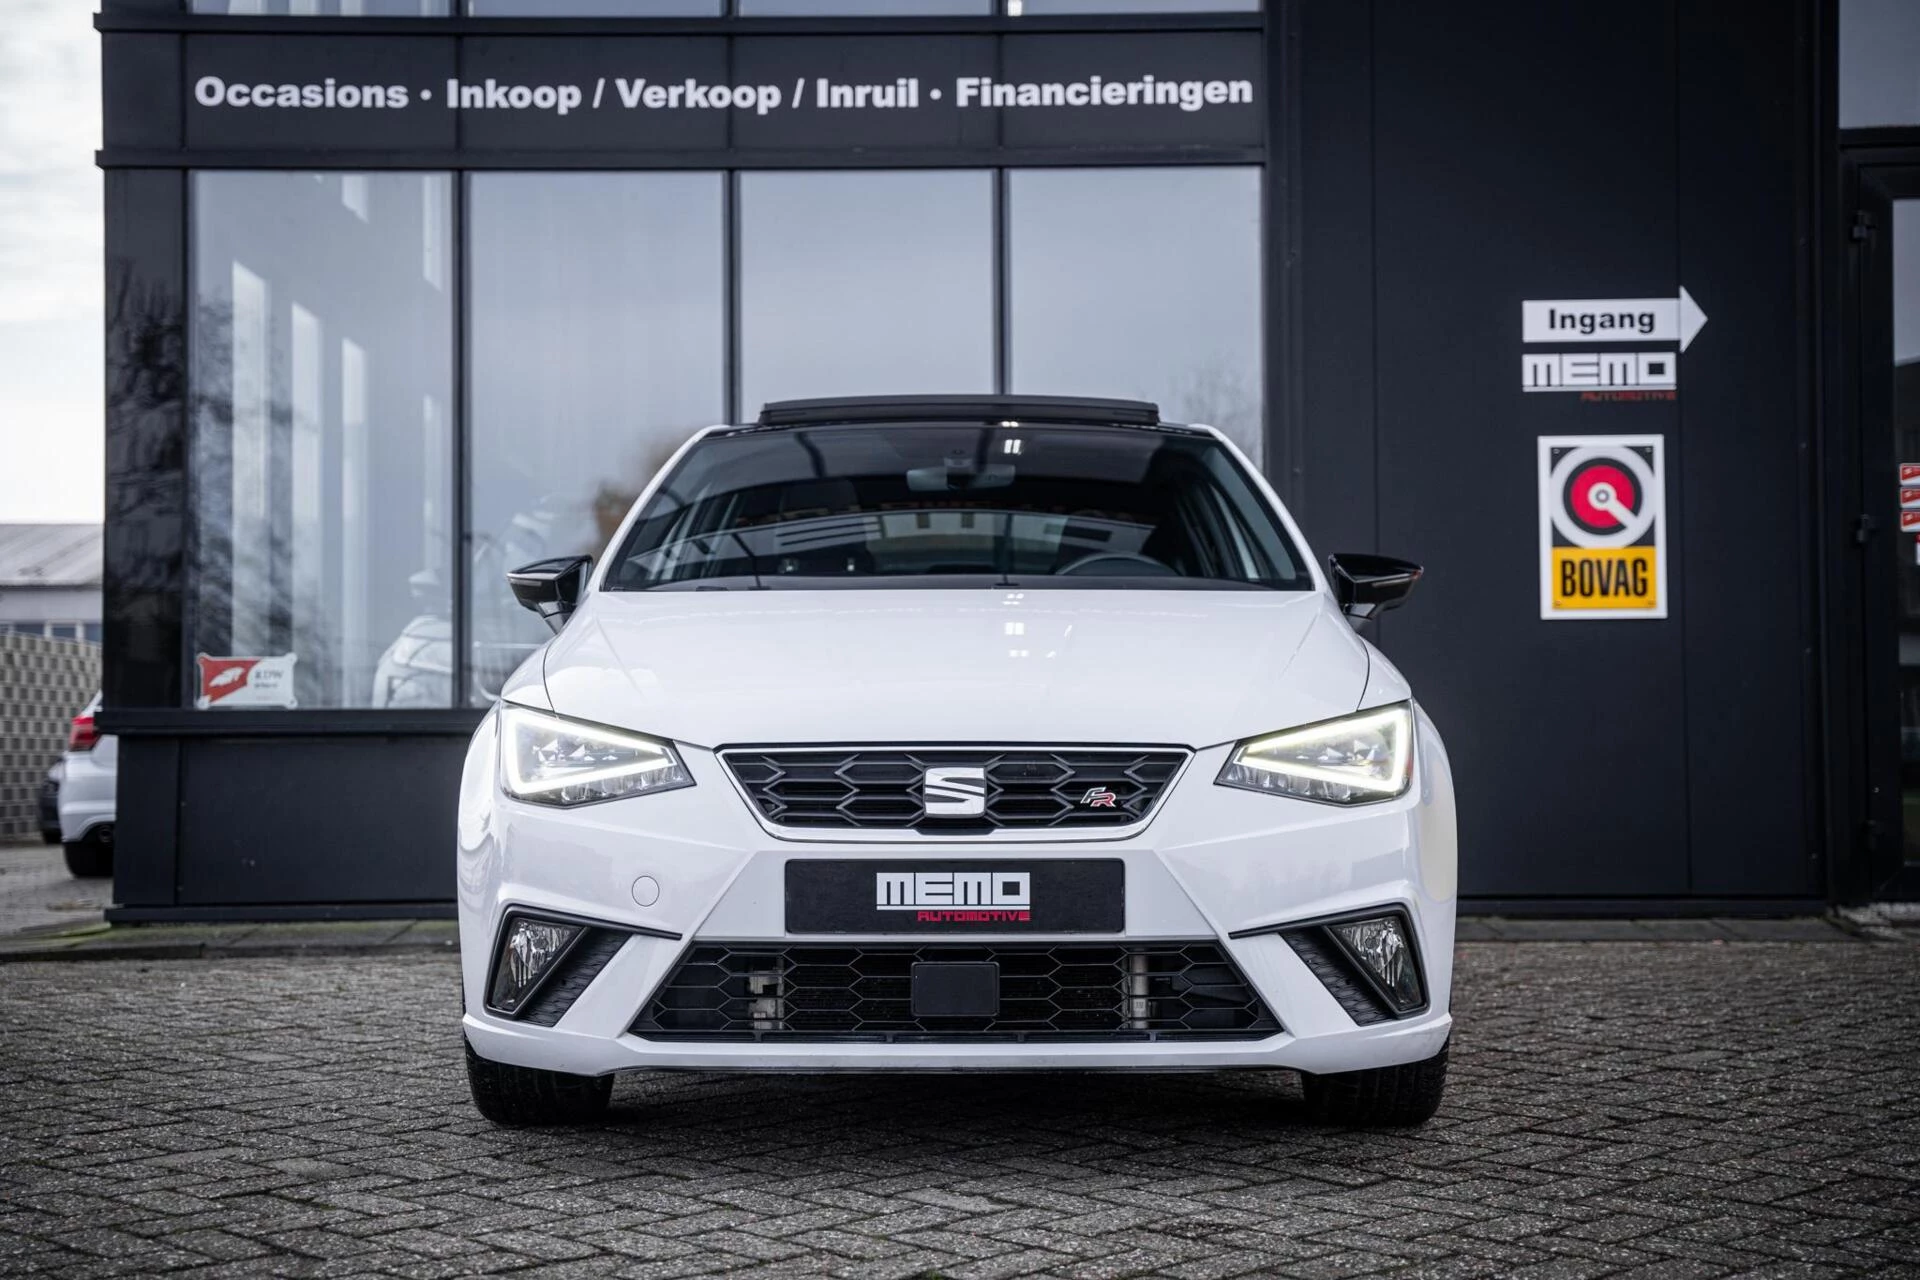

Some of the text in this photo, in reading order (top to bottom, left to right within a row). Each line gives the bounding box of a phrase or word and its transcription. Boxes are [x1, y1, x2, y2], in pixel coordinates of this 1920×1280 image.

[195, 77, 408, 108] Occasions
[447, 79, 581, 116] Inkoop
[615, 78, 782, 116] Verkoop
[817, 77, 919, 108] Inruil
[956, 74, 1253, 112] Financieringen
[1549, 309, 1656, 334] Ingang
[1522, 352, 1676, 386] MEMO
[1561, 558, 1648, 597] BOVAG
[1080, 786, 1117, 807] FR
[876, 872, 1030, 905] MEMO
[917, 911, 1031, 922] AUTOMOTIVE
